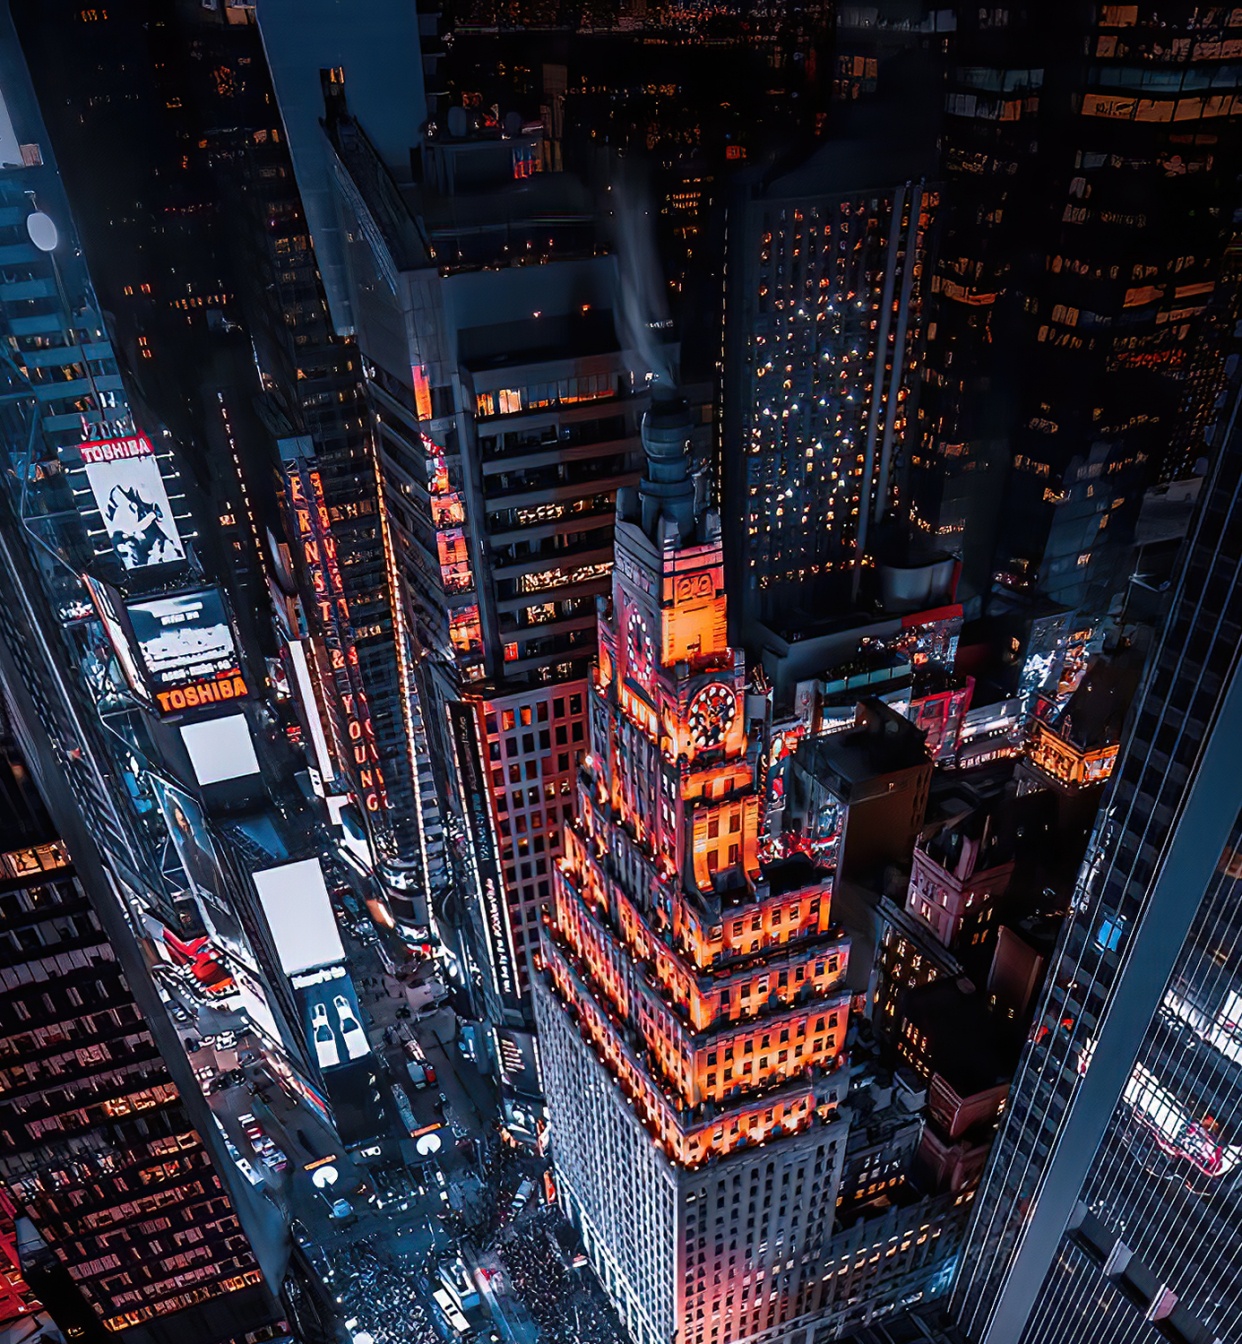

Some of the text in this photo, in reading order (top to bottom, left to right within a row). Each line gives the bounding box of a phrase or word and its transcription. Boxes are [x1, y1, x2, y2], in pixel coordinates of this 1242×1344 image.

[81, 438, 150, 462] TOSHIBA
[290, 475, 333, 621] ERNST
[341, 693, 379, 811] YOUNG
[156, 676, 248, 712] TOSHIBA
